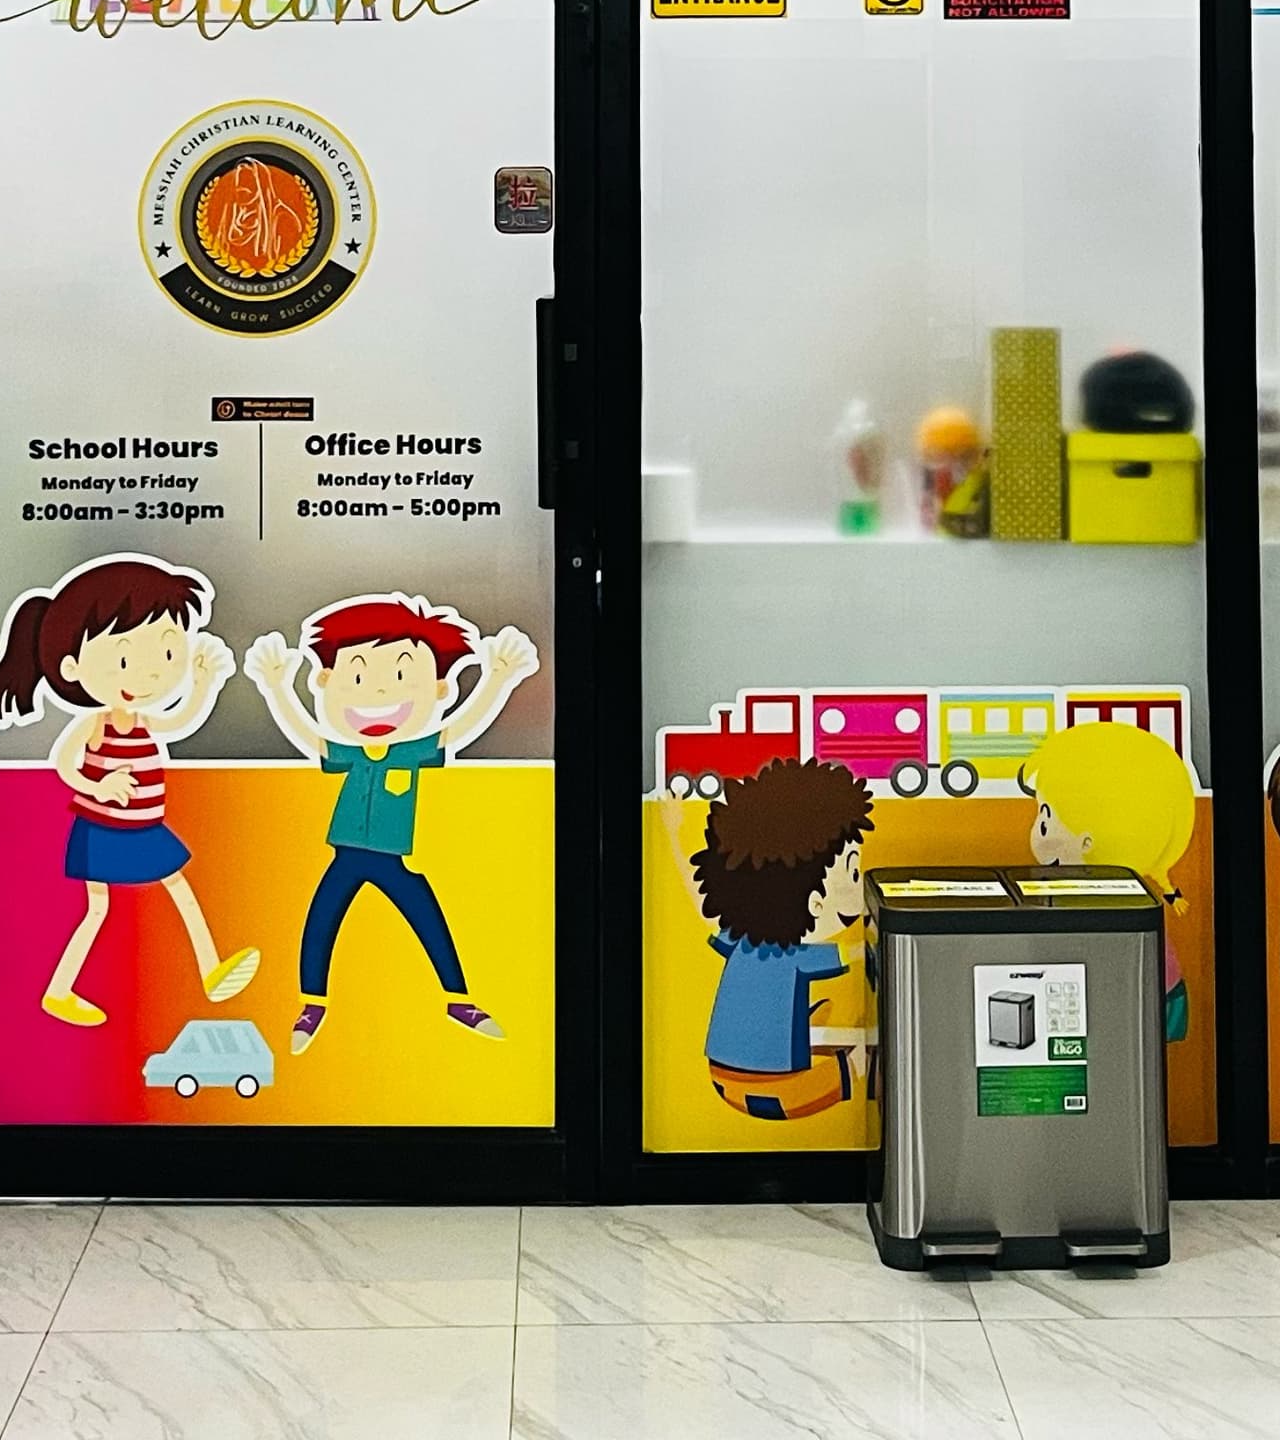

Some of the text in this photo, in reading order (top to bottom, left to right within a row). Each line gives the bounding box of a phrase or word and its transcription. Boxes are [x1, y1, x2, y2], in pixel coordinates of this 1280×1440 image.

[948, 8, 1067, 17] NOT ALLOWED
[154, 115, 362, 225] MESSIAH CHRISTIAN LEARNING CENTER
[185, 283, 333, 322] LEARN GROW SUCCEED
[28, 438, 218, 459] School Hours
[305, 432, 482, 456] Office Hours
[41, 474, 199, 494] Monday to Friday
[317, 470, 474, 490] Monday to Friday
[21, 501, 225, 526] 8:00am 3:30pm
[297, 498, 501, 522] 8:00am 5:00pm
